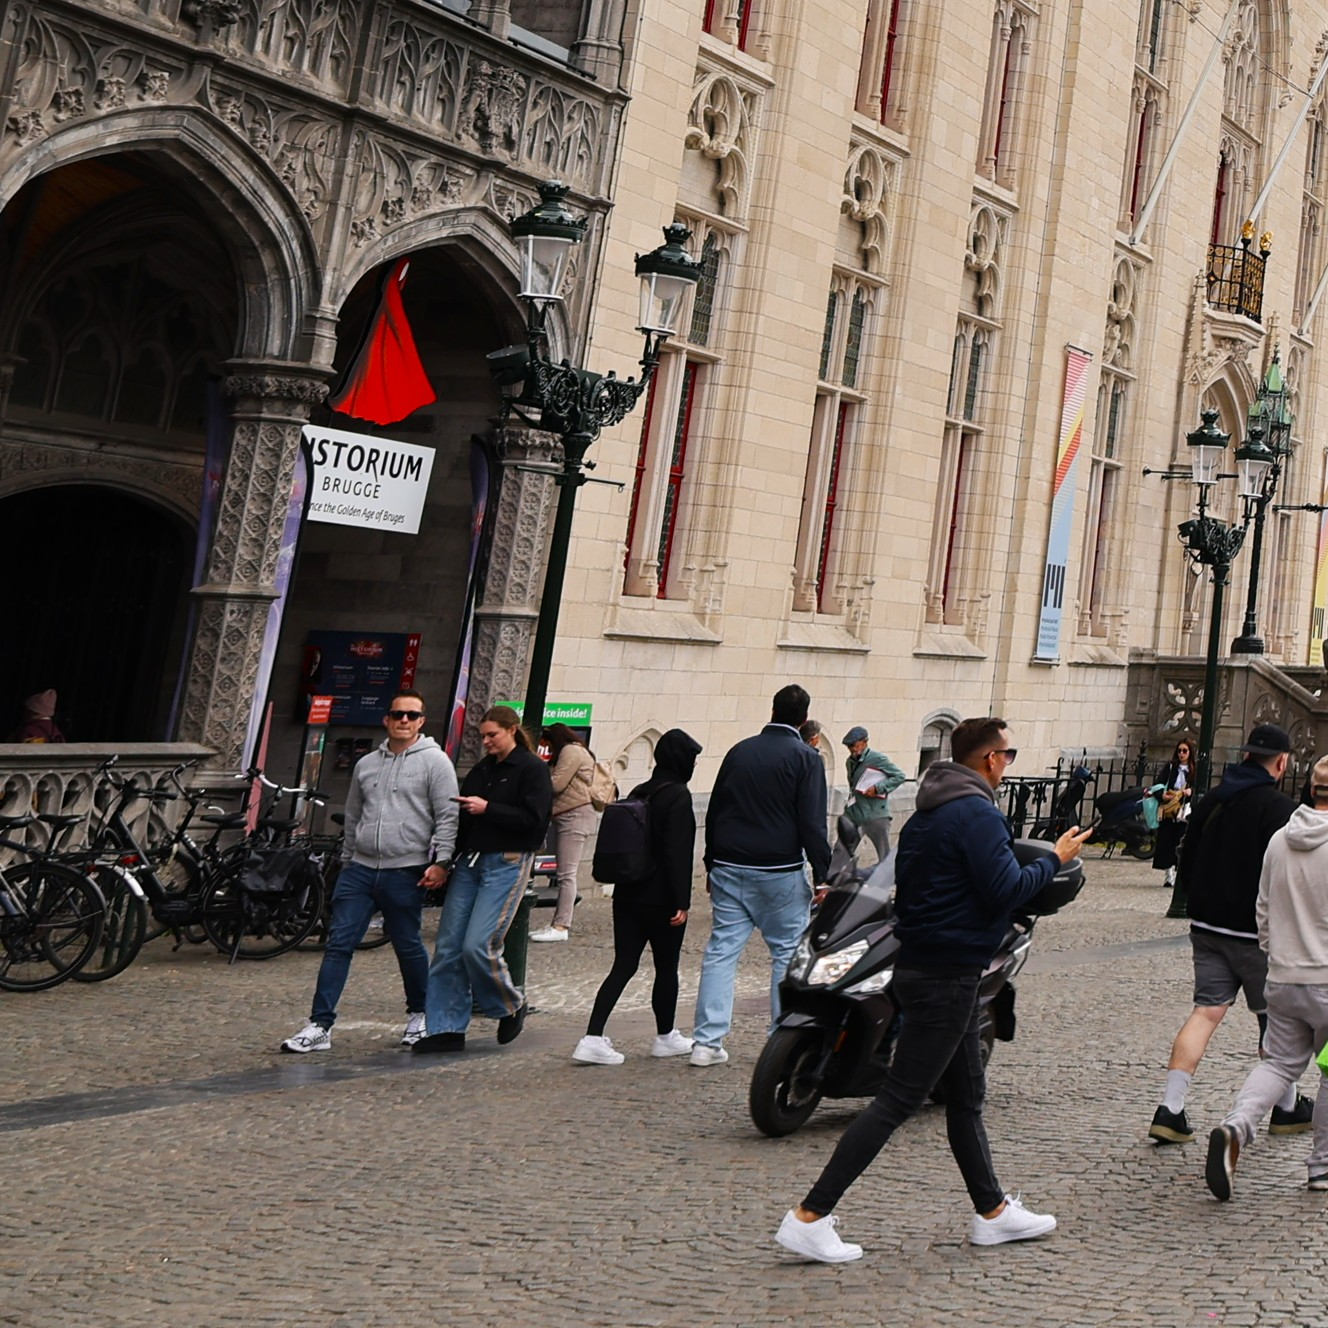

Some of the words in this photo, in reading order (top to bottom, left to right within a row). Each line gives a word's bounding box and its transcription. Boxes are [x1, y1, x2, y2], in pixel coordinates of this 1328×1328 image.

[310, 437, 423, 482] ISTORIUM
[322, 476, 381, 499] BRUGGE
[310, 502, 324, 513] nce
[323, 502, 337, 513] the
[337, 504, 361, 517] Golden
[361, 508, 375, 521] Age
[375, 509, 384, 520] of
[383, 510, 406, 525] Bruges
[543, 708, 557, 718] ice
[557, 707, 588, 719] inside!
